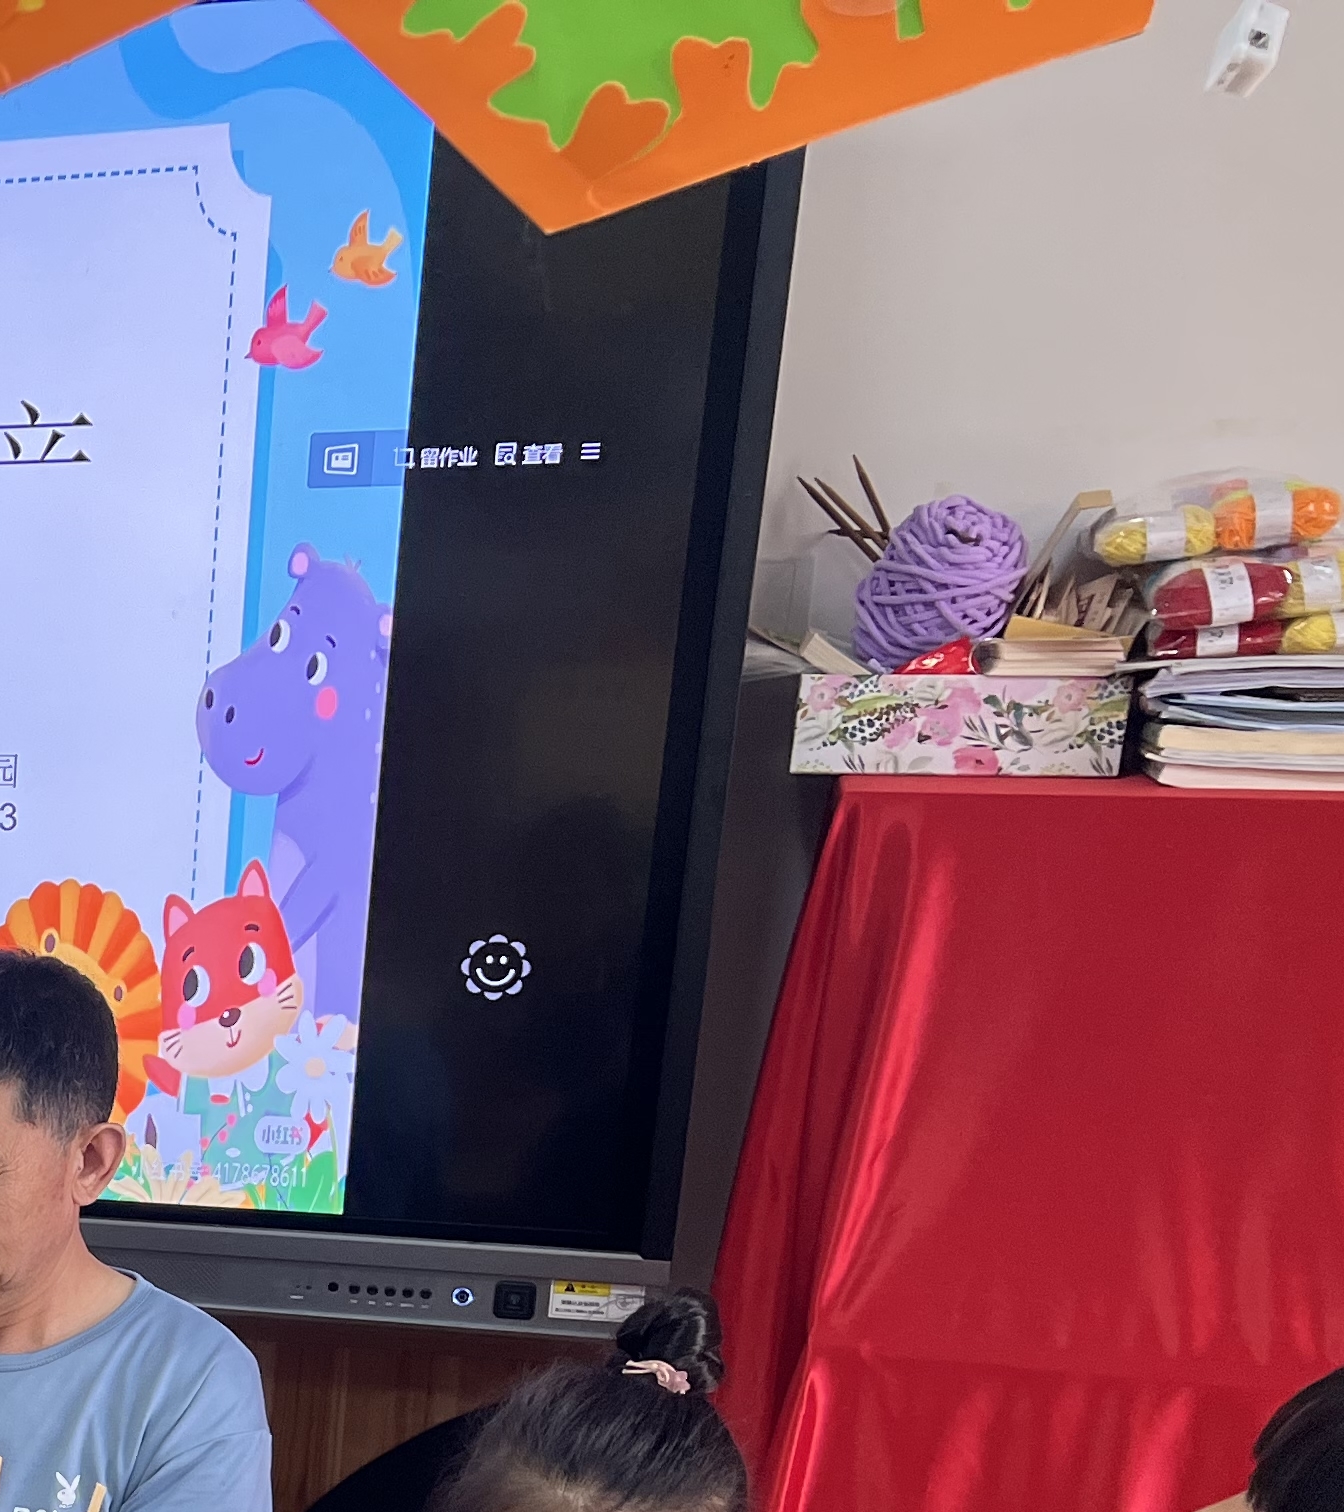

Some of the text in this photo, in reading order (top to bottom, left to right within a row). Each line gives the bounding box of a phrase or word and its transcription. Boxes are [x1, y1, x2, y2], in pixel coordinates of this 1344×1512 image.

[420, 442, 564, 469] 留作业 查看
